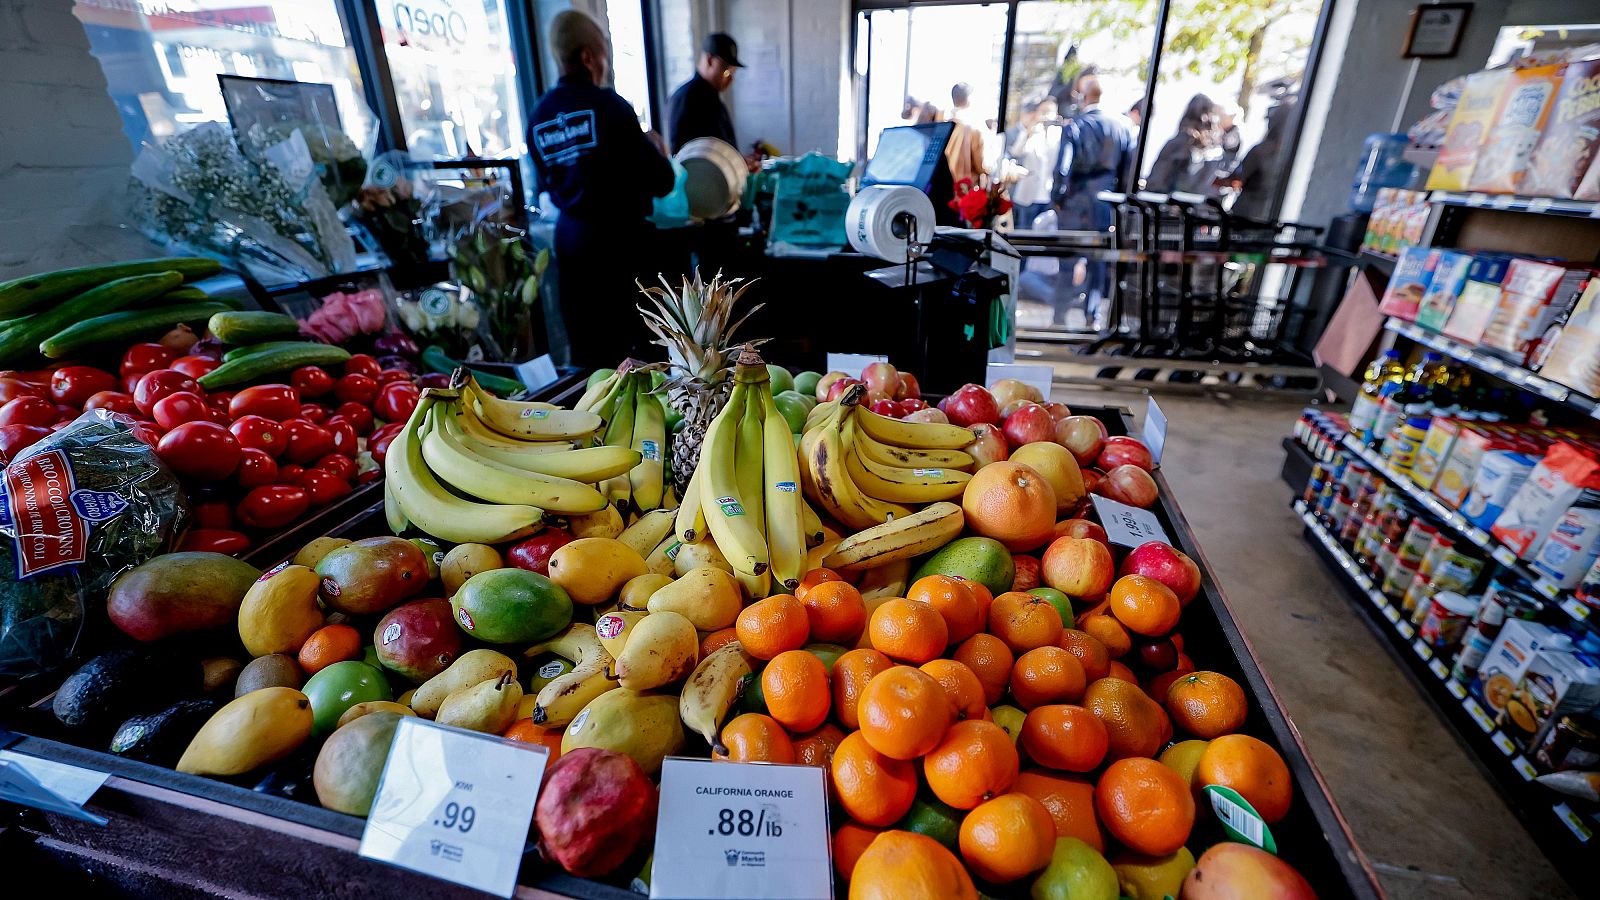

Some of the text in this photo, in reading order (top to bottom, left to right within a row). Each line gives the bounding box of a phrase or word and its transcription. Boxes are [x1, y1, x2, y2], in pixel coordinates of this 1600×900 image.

[37, 457, 74, 556] BROCCOLI CROWNS
[695, 786, 794, 798] CALIFORNIA ORANGE
[434, 801, 476, 833] .99
[708, 808, 783, 837] .88/lb
